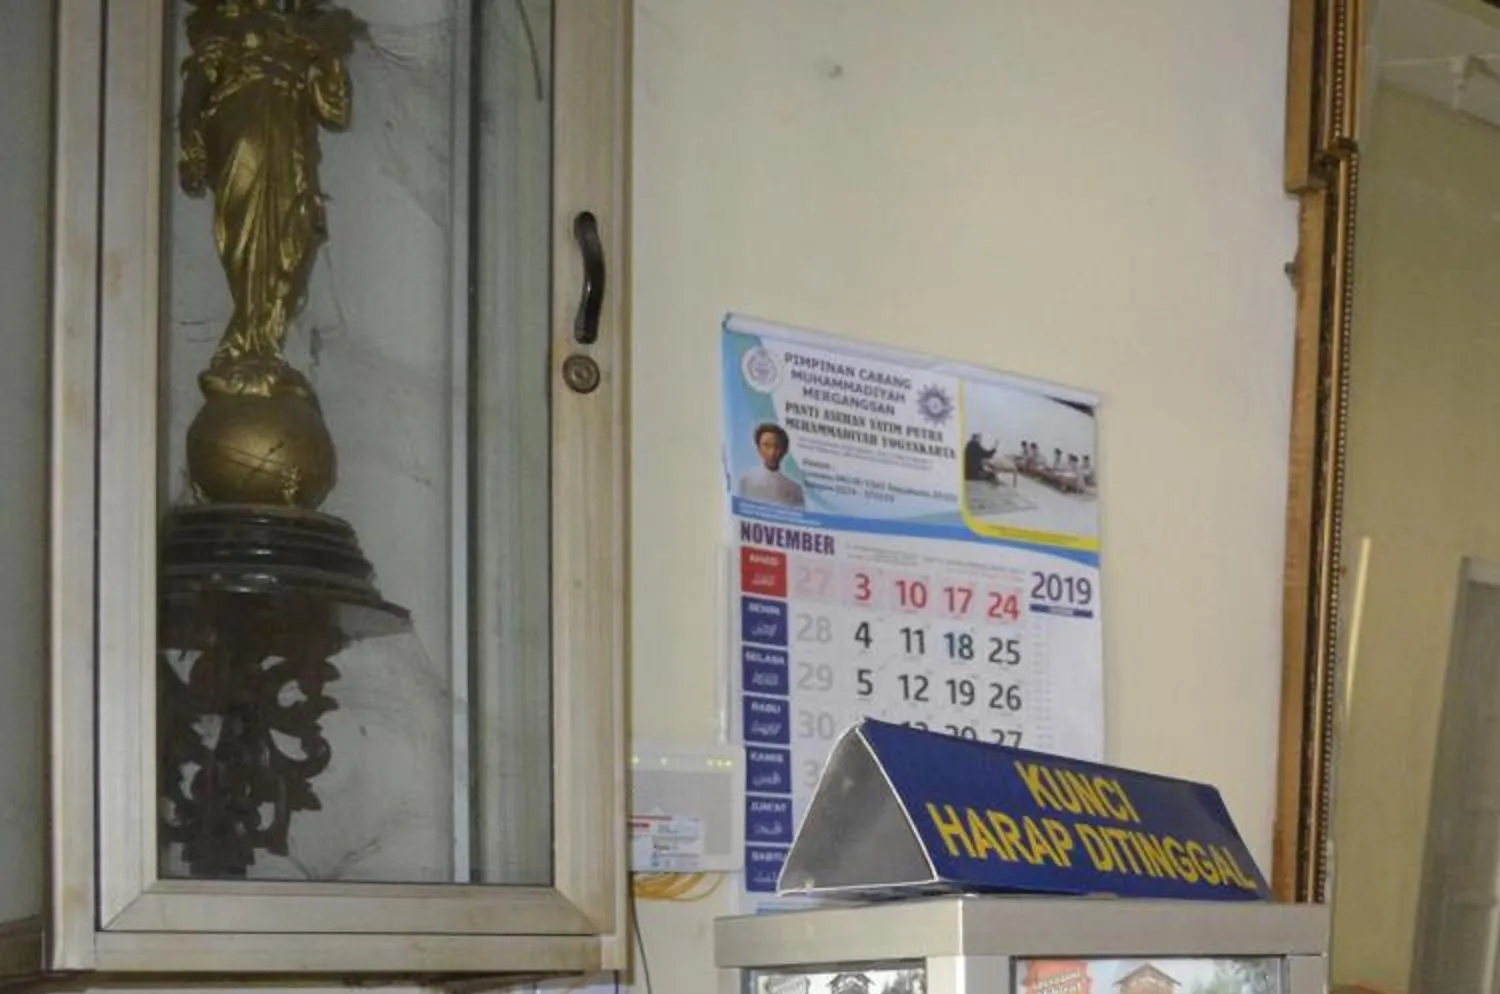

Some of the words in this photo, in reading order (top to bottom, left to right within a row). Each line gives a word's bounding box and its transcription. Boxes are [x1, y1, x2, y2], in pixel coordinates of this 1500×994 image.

[784, 352, 855, 377] PIMPINAN
[859, 368, 911, 389] CABANG
[790, 370, 905, 402] MUHAMMADIYAH
[803, 387, 895, 416] MERGANGSAN
[740, 522, 835, 556] NOVEMBER
[854, 572, 871, 601] 3
[896, 580, 928, 609] 10
[944, 587, 973, 613] 17
[988, 592, 1020, 620] 24
[1030, 571, 1092, 605] 2019
[797, 613, 832, 643] 28
[854, 621, 872, 649] 4
[900, 628, 925, 655] 11
[943, 632, 975, 661] 18
[988, 637, 1020, 665] 25
[798, 663, 834, 692] 29
[856, 669, 873, 696] 5
[898, 674, 928, 702] 12
[946, 679, 975, 706] 19
[989, 683, 1021, 711] 26
[799, 711, 834, 739] 30
[1014, 760, 1141, 823] KUNCI
[926, 803, 1074, 868] HARAP
[1073, 823, 1258, 890] DITINGGAL
